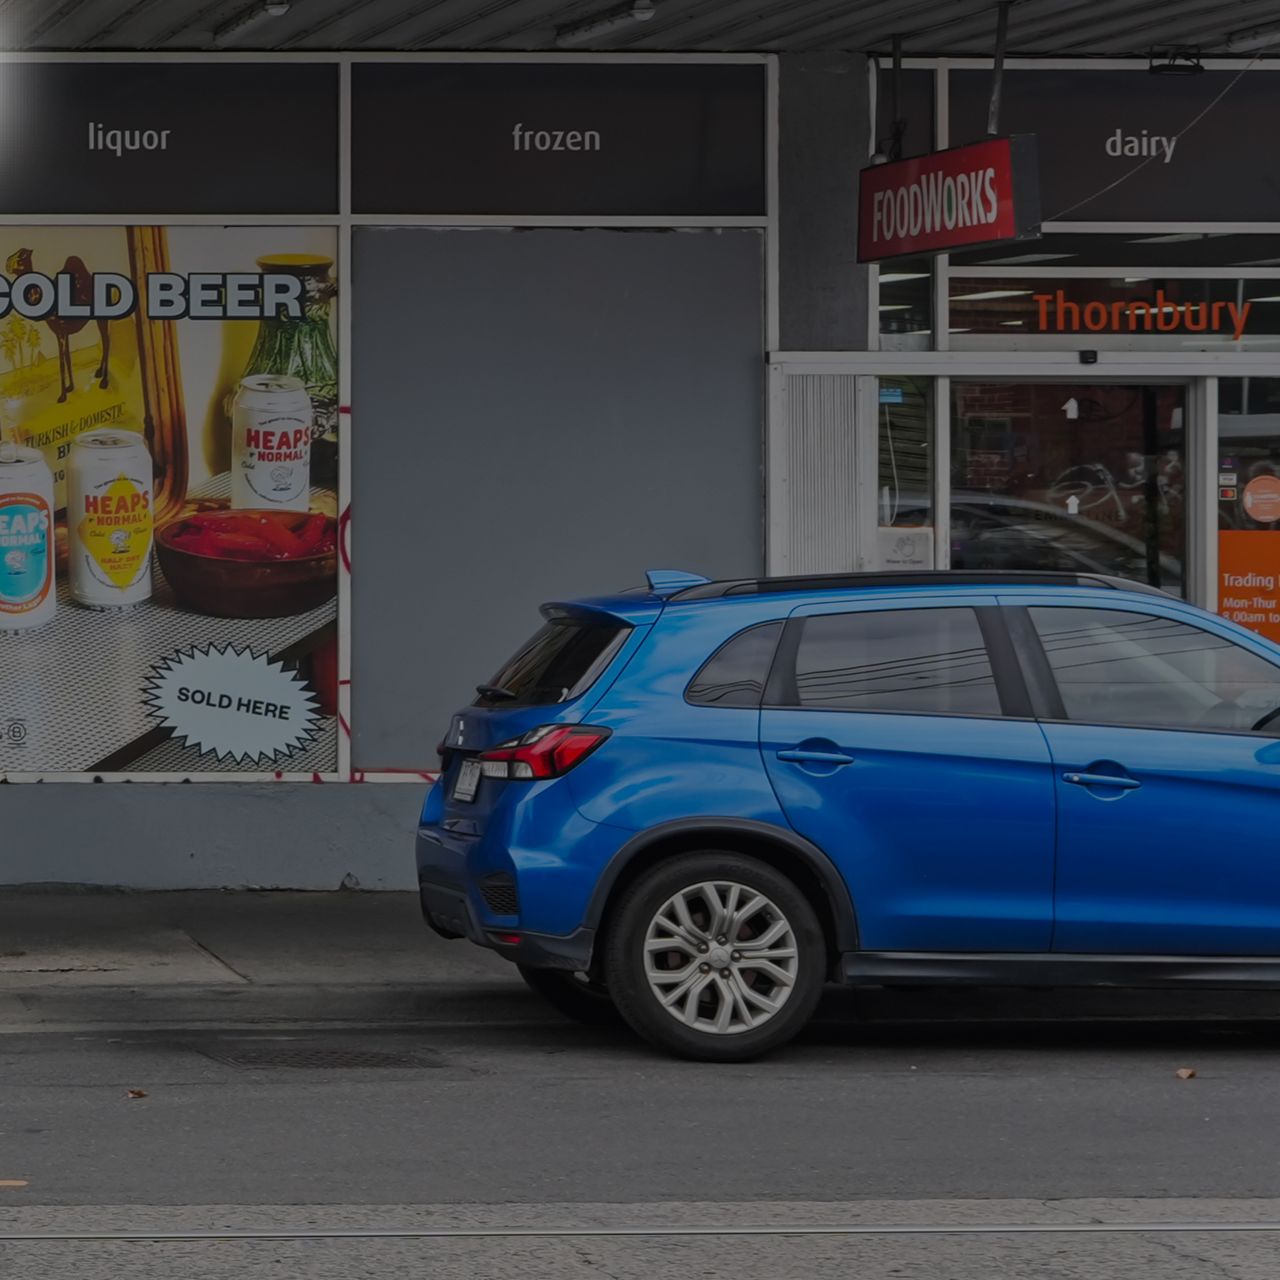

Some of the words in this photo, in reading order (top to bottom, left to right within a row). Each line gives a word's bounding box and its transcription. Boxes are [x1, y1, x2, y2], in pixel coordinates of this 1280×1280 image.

[88, 121, 171, 157] liquor
[511, 122, 600, 151] frozen
[1105, 129, 1177, 163] dairy
[146, 271, 307, 320] BEER
[1032, 289, 1252, 340] Thornbury
[79, 402, 126, 432] DOMESTIC
[246, 426, 310, 450] HEAPS
[257, 449, 303, 462] NORMAL
[84, 490, 149, 515] HEAPS
[96, 513, 143, 526] NORMAL
[1223, 573, 1274, 590] Trading
[1223, 596, 1277, 609] Mon-Thur
[177, 686, 233, 710] SOLD
[236, 696, 291, 721] HERE
